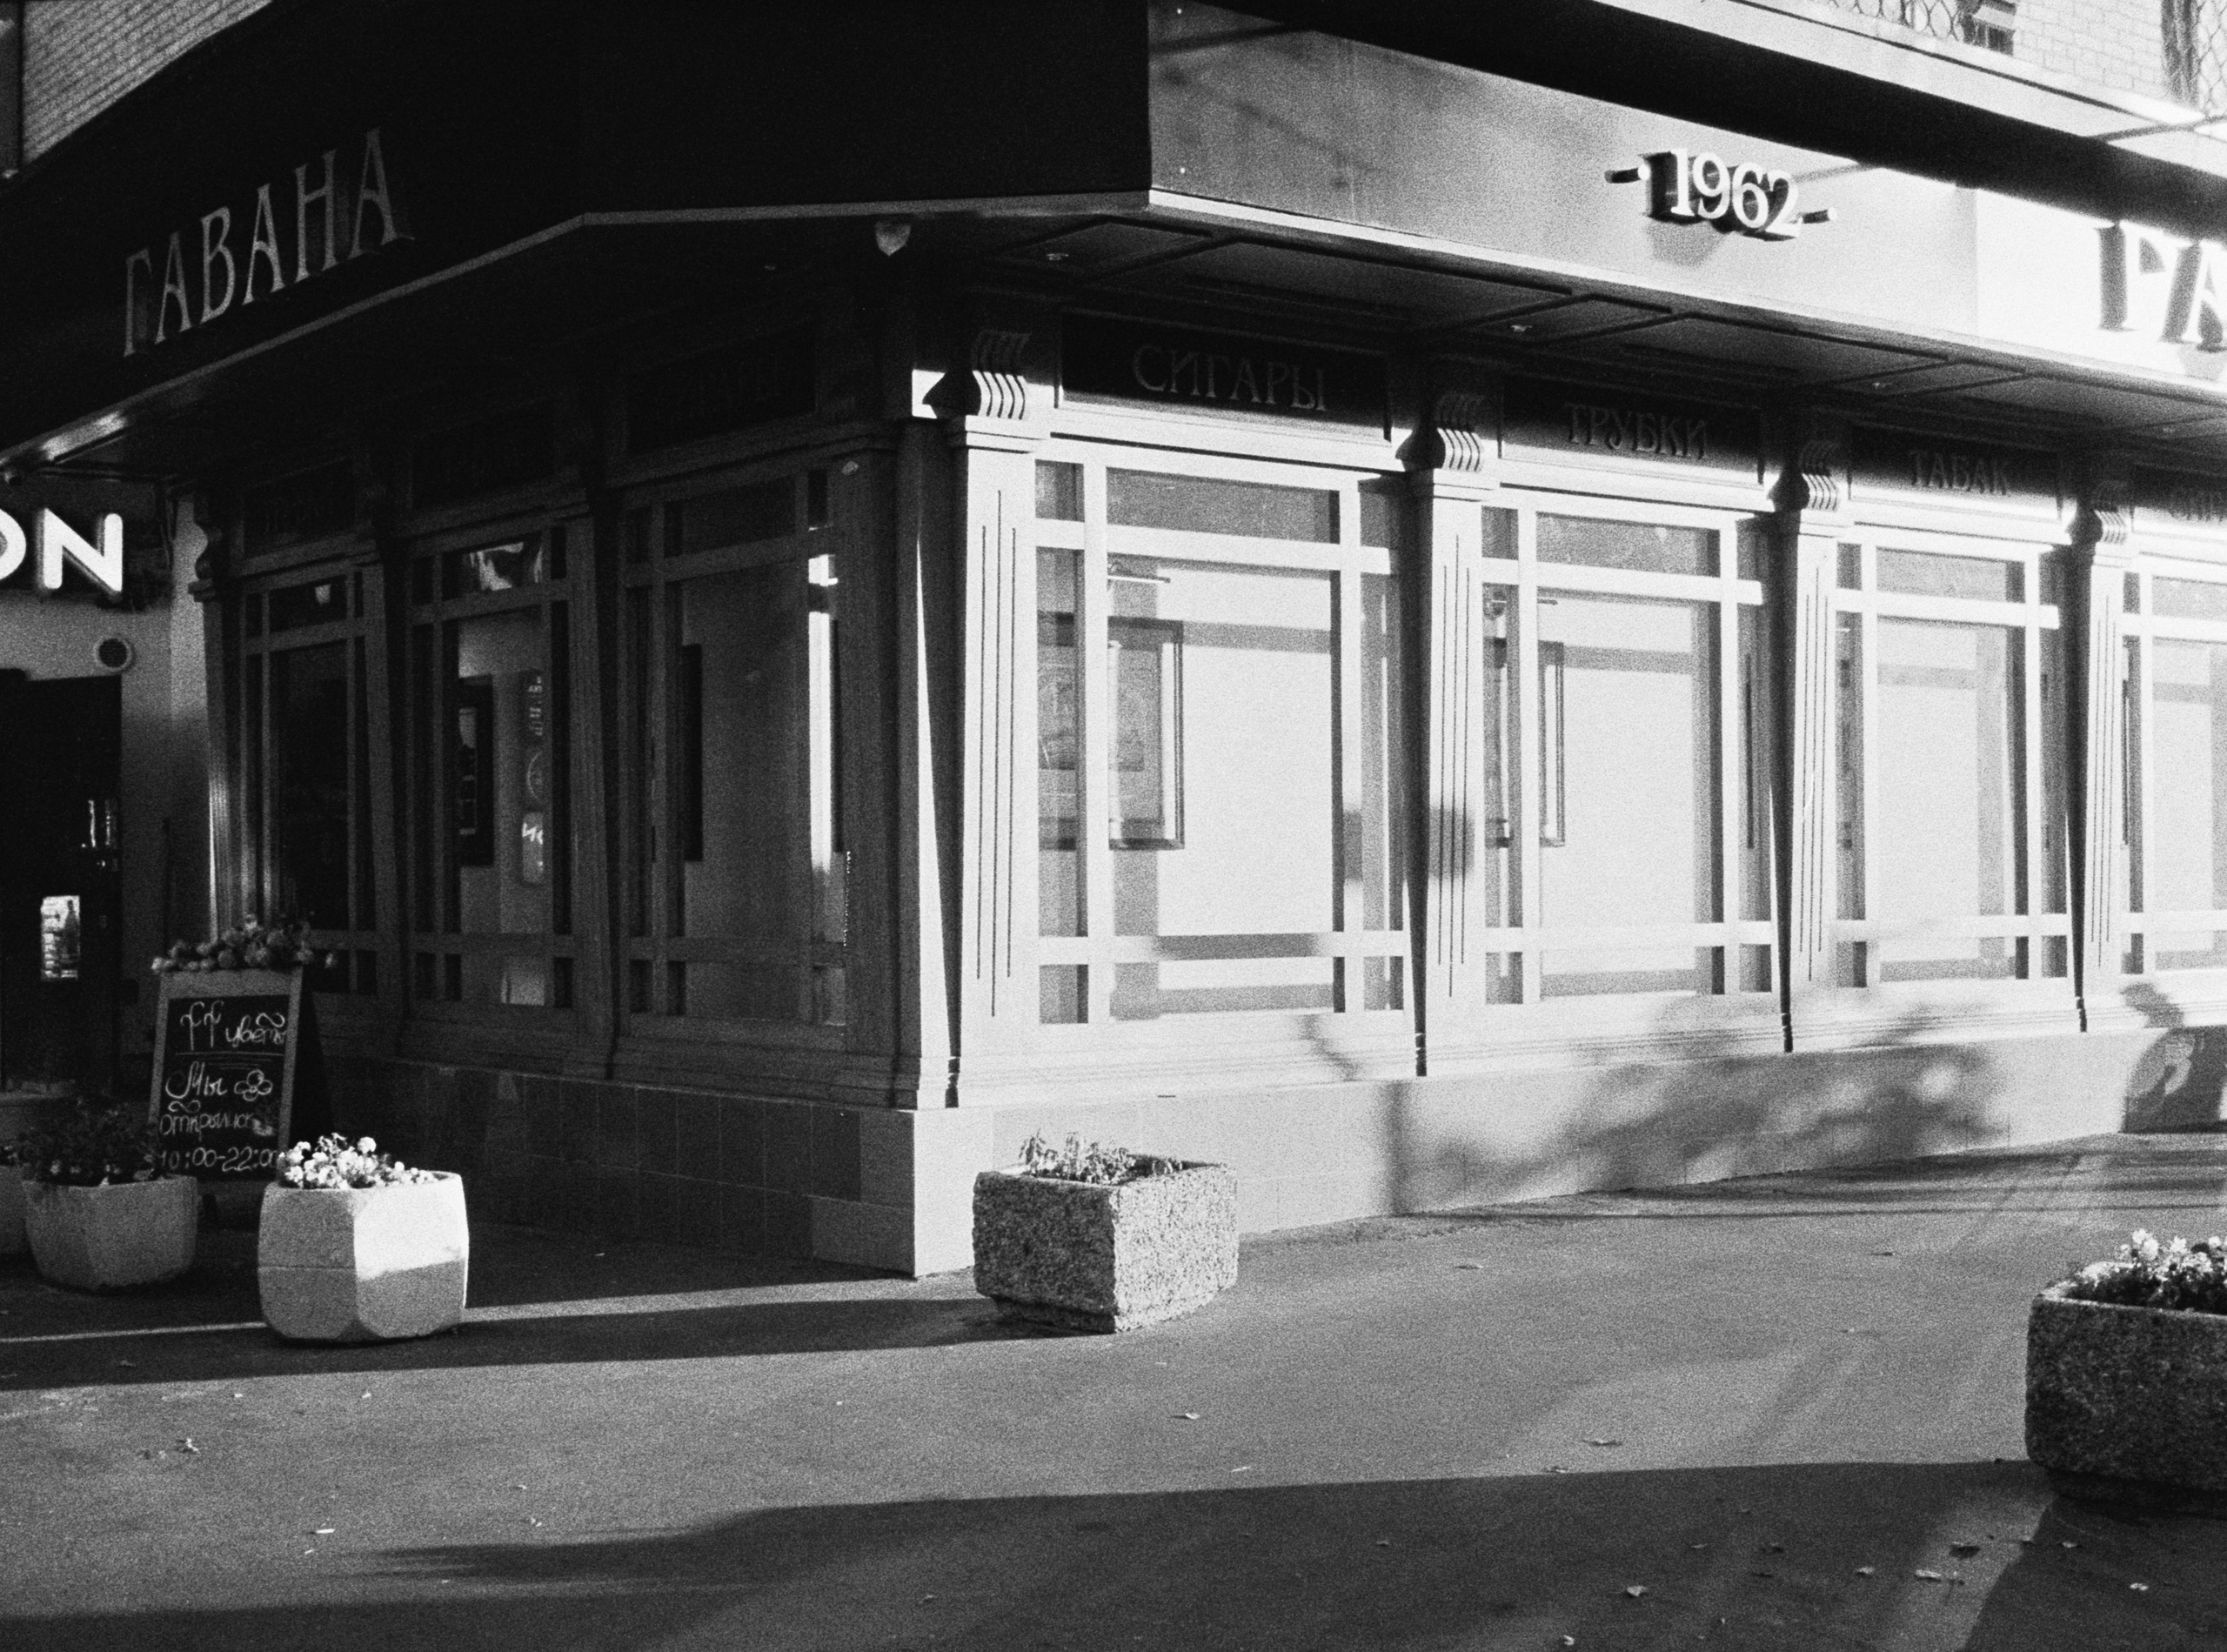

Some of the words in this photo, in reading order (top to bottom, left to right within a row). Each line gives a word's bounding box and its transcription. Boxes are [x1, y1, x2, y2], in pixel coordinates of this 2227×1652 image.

[1642, 146, 1804, 242] 1962
[123, 126, 403, 358] ГАВАНА
[1132, 344, 1327, 412] СИГАРЫ
[1564, 402, 1708, 459] ТРУБКИ
[1907, 449, 2010, 495] ТАБАК
[165, 1060, 229, 1100] Мы
